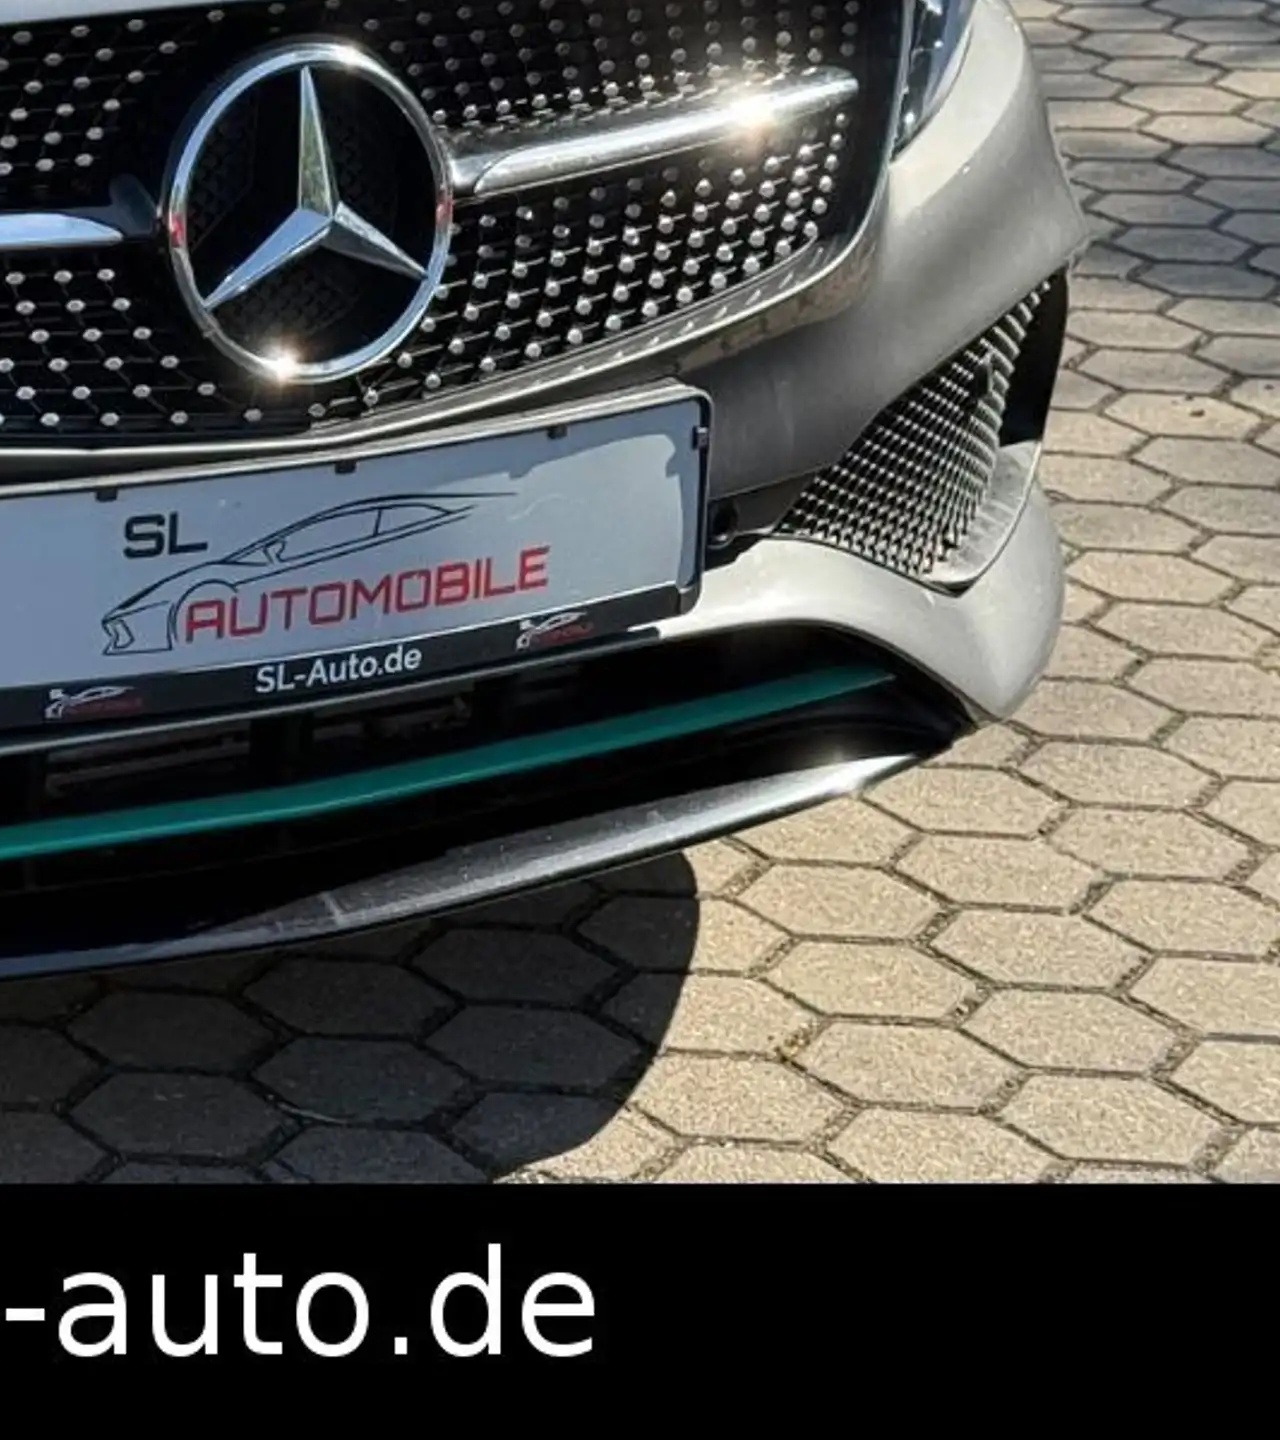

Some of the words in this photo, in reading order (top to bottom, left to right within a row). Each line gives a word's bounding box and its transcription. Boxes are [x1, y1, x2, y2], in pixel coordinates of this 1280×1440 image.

[123, 511, 208, 559] SL
[185, 545, 551, 643] AUTOMOBILE
[255, 643, 423, 694] SL-Auto.de
